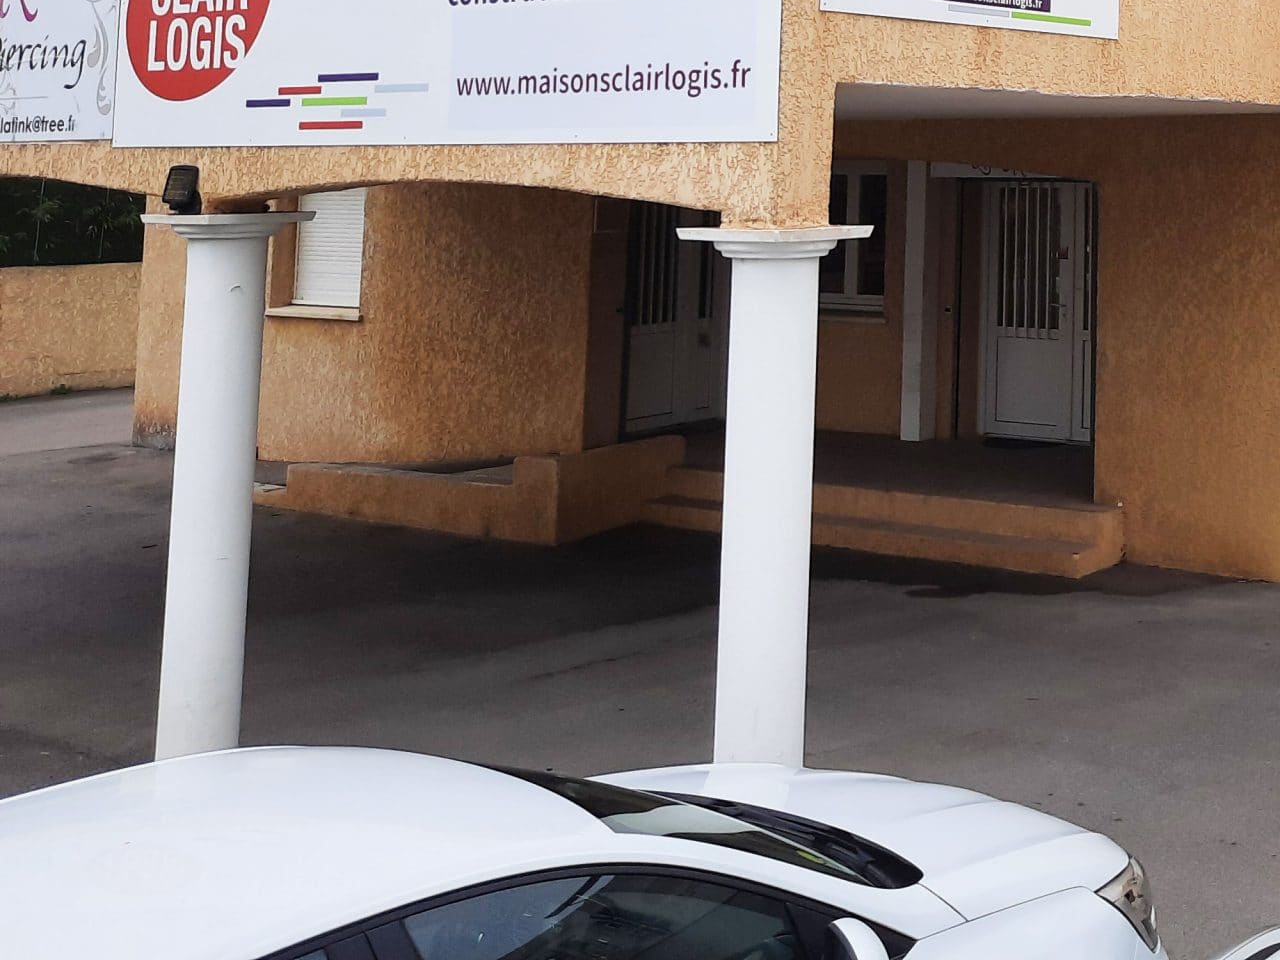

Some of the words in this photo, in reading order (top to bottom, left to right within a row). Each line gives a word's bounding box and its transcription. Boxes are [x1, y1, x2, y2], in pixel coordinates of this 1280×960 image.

[0, 34, 87, 90] iercing
[147, 14, 247, 72] LOGIS
[456, 59, 752, 98] www.maisonsclairlogis.fr
